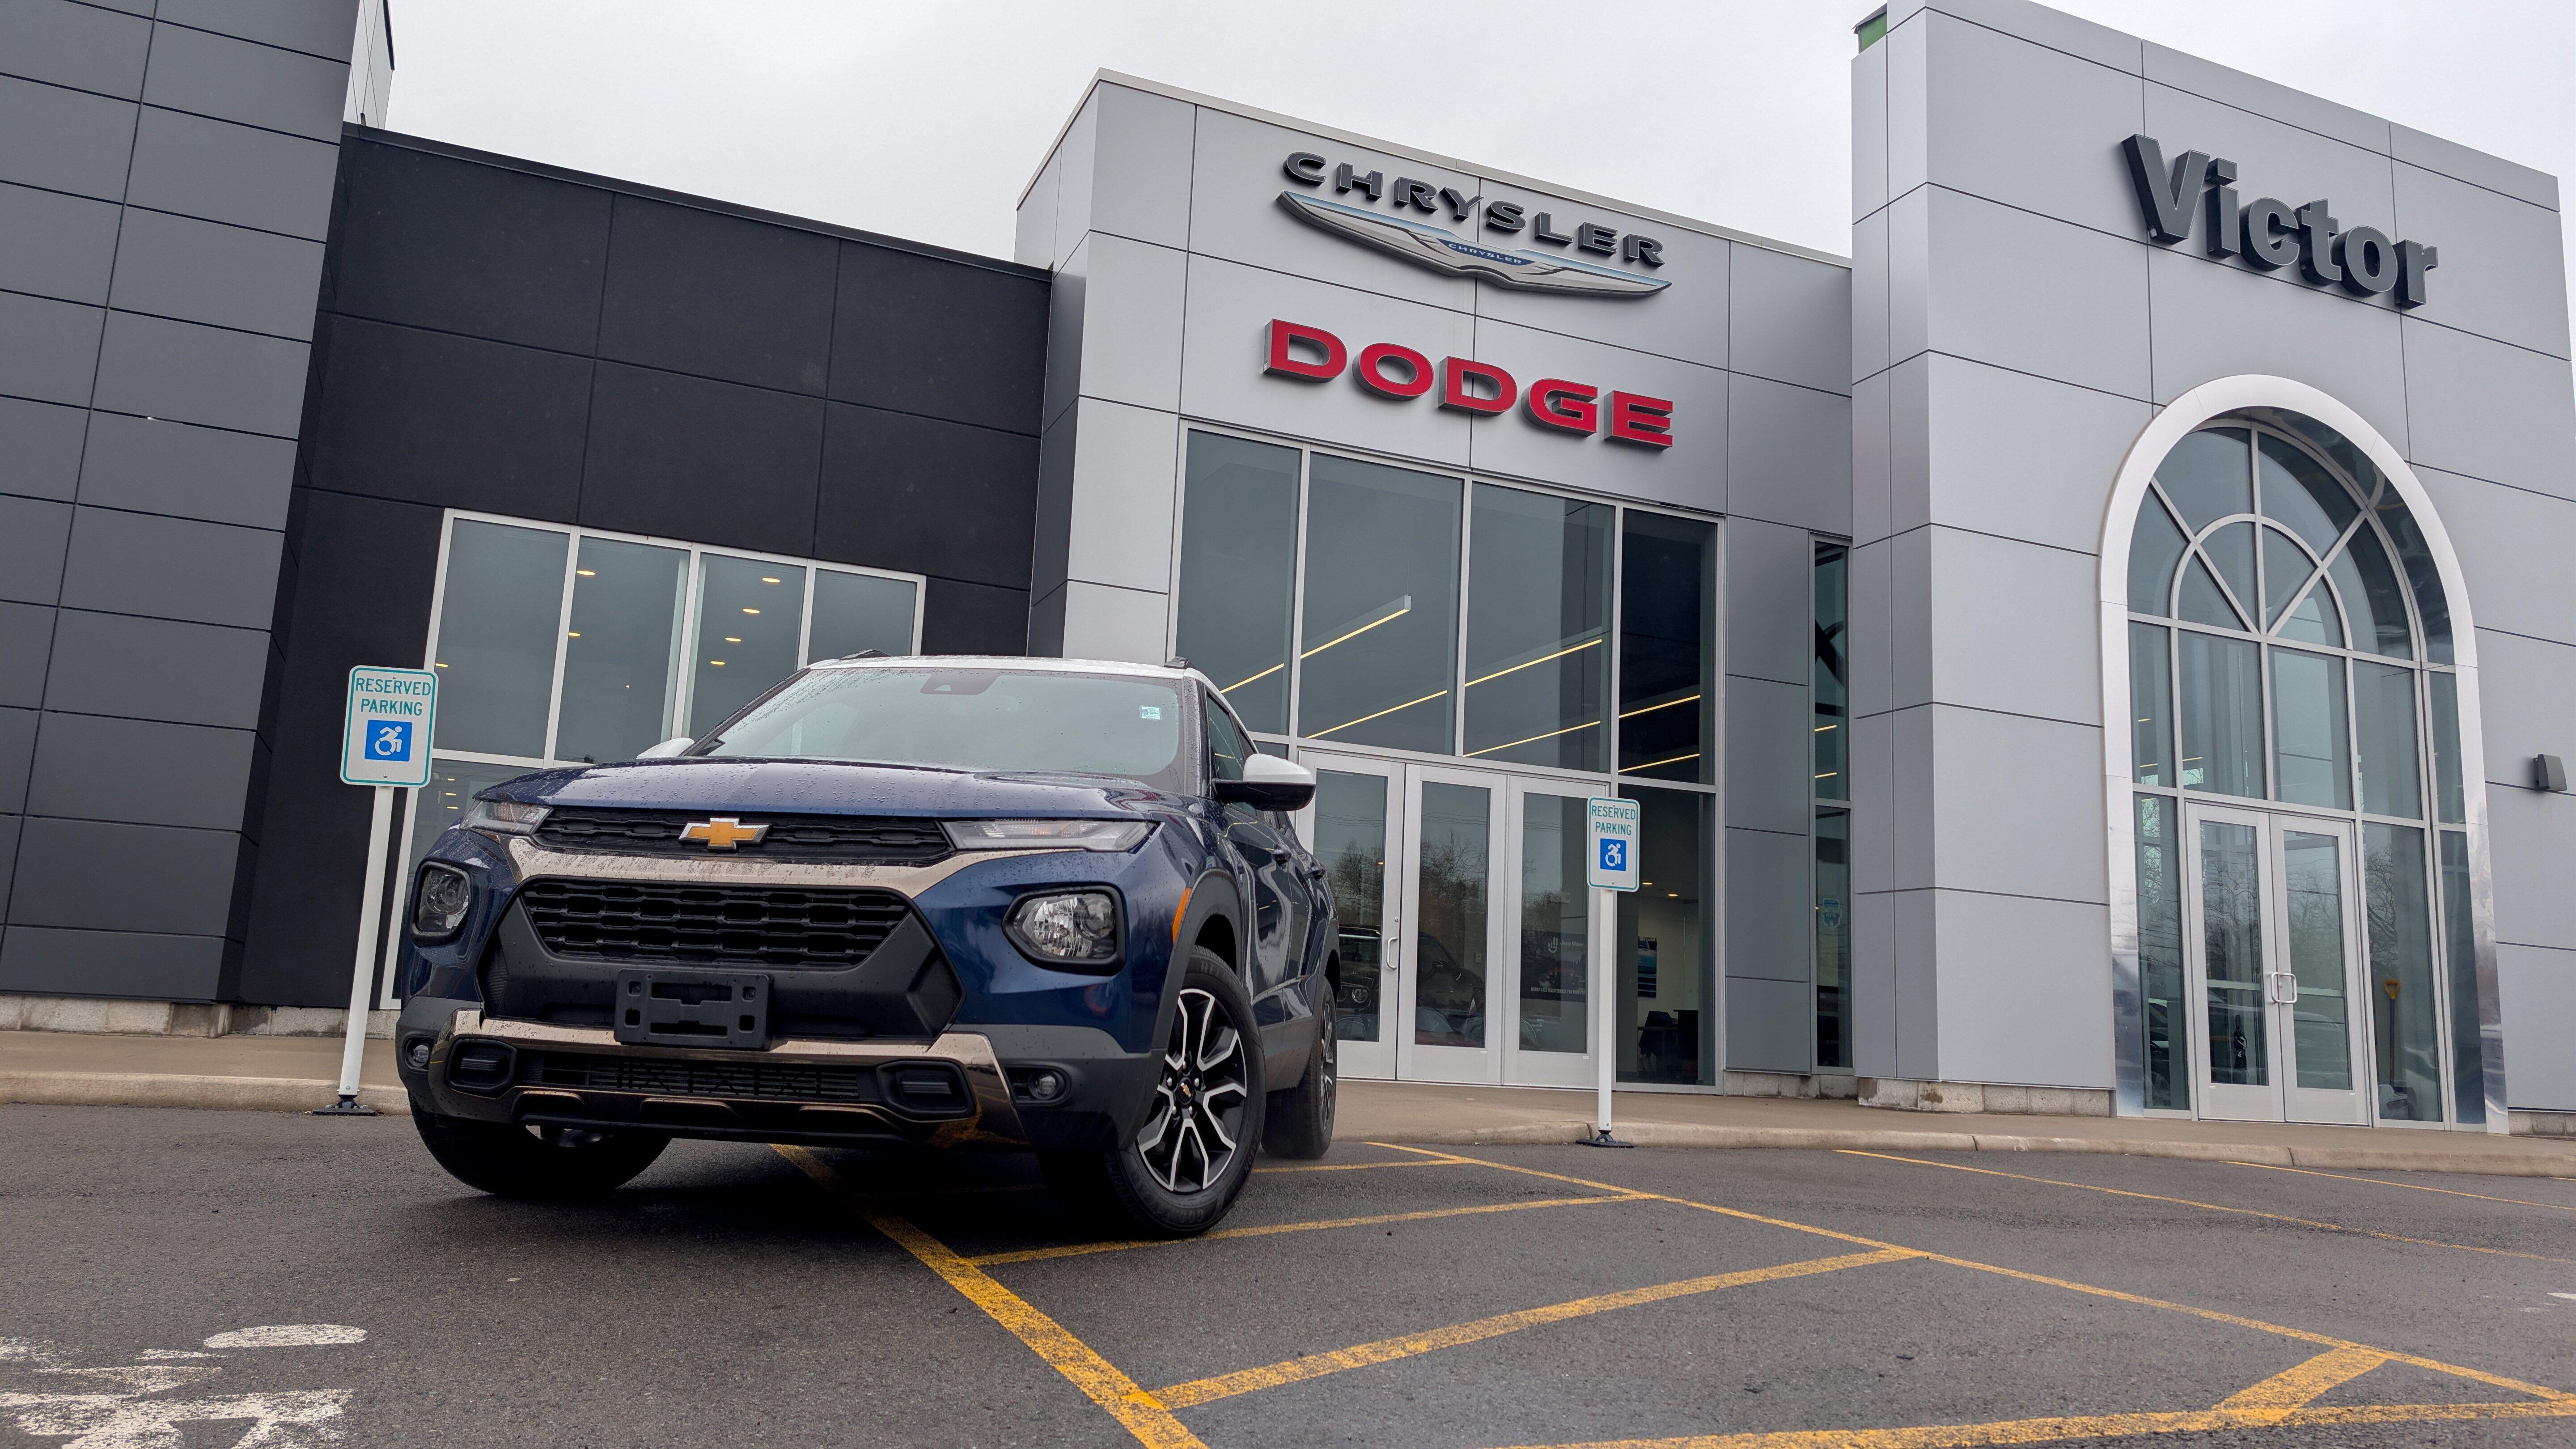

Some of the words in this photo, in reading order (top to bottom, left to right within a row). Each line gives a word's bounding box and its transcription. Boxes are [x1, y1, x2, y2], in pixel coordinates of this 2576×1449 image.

[1283, 152, 1665, 267] CHRYSLER
[2122, 134, 2438, 309] Victor
[1448, 244, 1521, 264] CHRYSLER
[1263, 318, 1674, 451] DODGE
[355, 677, 431, 696] RESERVED
[360, 698, 423, 716] PARKING
[1591, 805, 1636, 820] RESERVED
[1595, 822, 1632, 836] PARKING
